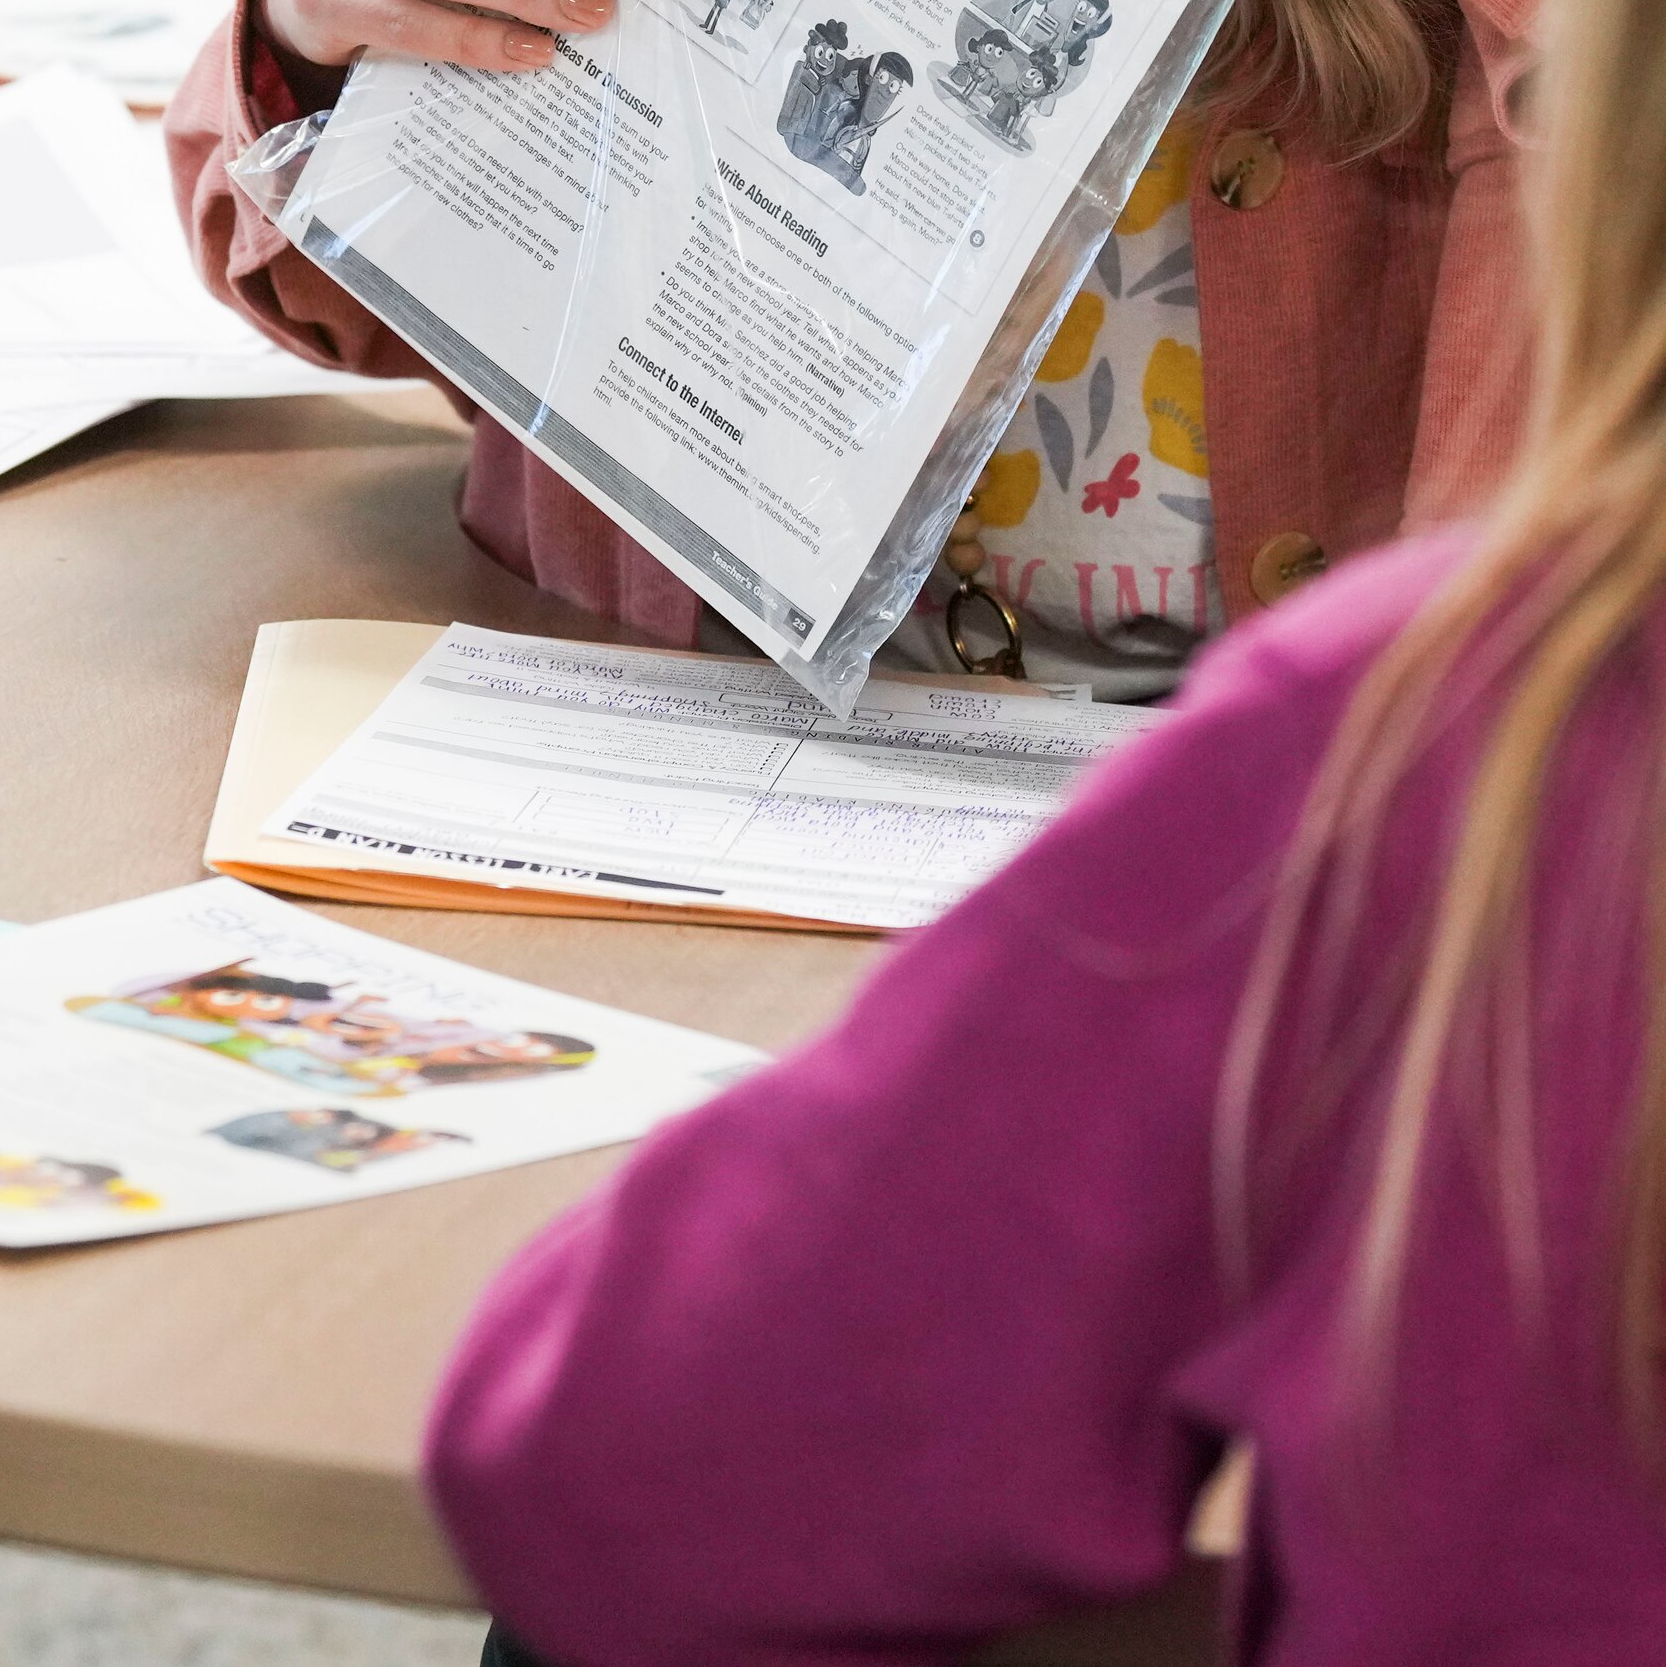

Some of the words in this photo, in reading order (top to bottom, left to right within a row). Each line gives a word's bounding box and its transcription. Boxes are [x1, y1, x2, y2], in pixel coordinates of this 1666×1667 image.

[552, 32, 585, 68] Ideas
[582, 57, 603, 80] for
[600, 71, 665, 128] Dscussion
[427, 65, 448, 86] Why
[455, 90, 474, 107] you
[472, 101, 494, 122] think
[492, 116, 520, 142] Marco
[516, 138, 552, 168] changes
[550, 162, 566, 178] his
[563, 173, 587, 194] mind
[583, 190, 610, 213] abut
[428, 151, 447, 168] you
[445, 162, 467, 183] think
[464, 178, 482, 194] will
[477, 188, 510, 217] happen
[507, 212, 524, 228] the
[521, 224, 542, 242] next
[539, 237, 560, 256] time
[712, 156, 747, 191] Write
[743, 182, 782, 220] About
[778, 208, 829, 258] Reading
[673, 260, 703, 285] seems
[709, 289, 742, 316] chnge
[749, 320, 769, 338] you
[767, 331, 788, 352] help
[785, 346, 806, 367] him.
[804, 361, 846, 399] (Narrative)
[680, 246, 696, 261] try
[722, 276, 750, 303] Marco
[747, 297, 768, 316] find
[764, 311, 787, 333] what
[796, 337, 823, 361] wants
[820, 356, 841, 374] and
[837, 368, 858, 387] how
[855, 382, 886, 408] Marco
[754, 225, 787, 253] choose
[784, 248, 803, 266] one
[811, 267, 833, 288] both
[840, 290, 858, 307] the
[854, 301, 893, 337] following
[891, 331, 925, 360] option
[591, 384, 615, 407] html.
[617, 335, 667, 382] Connect
[664, 372, 681, 392] to
[677, 383, 701, 409] the
[698, 399, 746, 445] Internet
[644, 316, 675, 343] explain
[672, 338, 692, 357] why
[699, 359, 719, 378] why
[716, 373, 735, 390] not.
[597, 373, 631, 402] provide
[629, 396, 645, 413] the
[642, 406, 681, 443] following
[678, 434, 699, 455] link:
[616, 367, 637, 388] help
[635, 384, 670, 414] children
[667, 407, 691, 430] learn
[688, 425, 711, 447] more
[709, 443, 736, 467] about
[757, 480, 783, 505] smart
[780, 500, 823, 538] shoppers,
[710, 551, 753, 589] Teacher's
[988, 552, 1219, 644] KIN
[789, 614, 809, 634] 29
